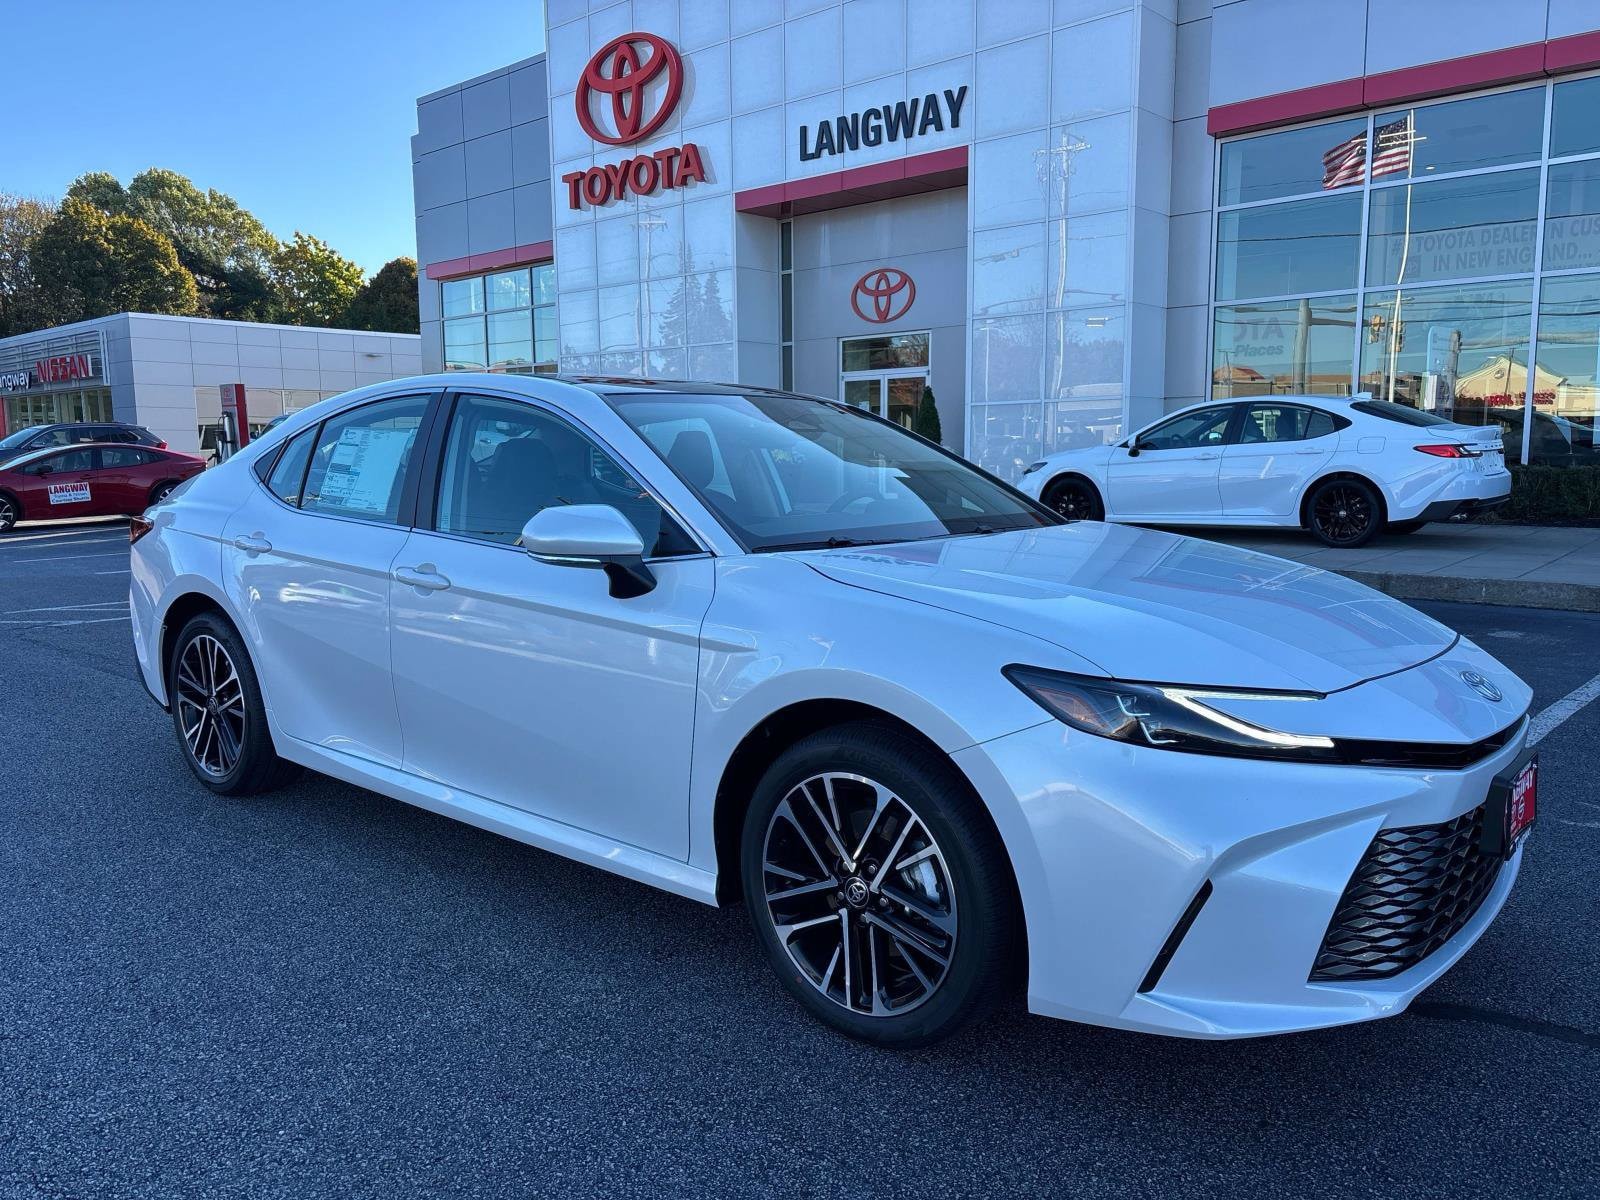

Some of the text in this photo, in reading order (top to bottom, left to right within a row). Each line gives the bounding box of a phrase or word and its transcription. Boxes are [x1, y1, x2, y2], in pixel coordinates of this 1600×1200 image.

[799, 85, 968, 162] LANGWAY
[562, 143, 706, 209] TOYOTA
[1416, 229, 1475, 253] TOYOTA
[1433, 254, 1450, 272] IN
[1455, 250, 1493, 270] NEW
[1498, 242, 1592, 267] ENGND...
[1234, 344, 1284, 358] Places
[36, 353, 92, 383] NISSAN
[49, 484, 88, 494] LANGWAY
